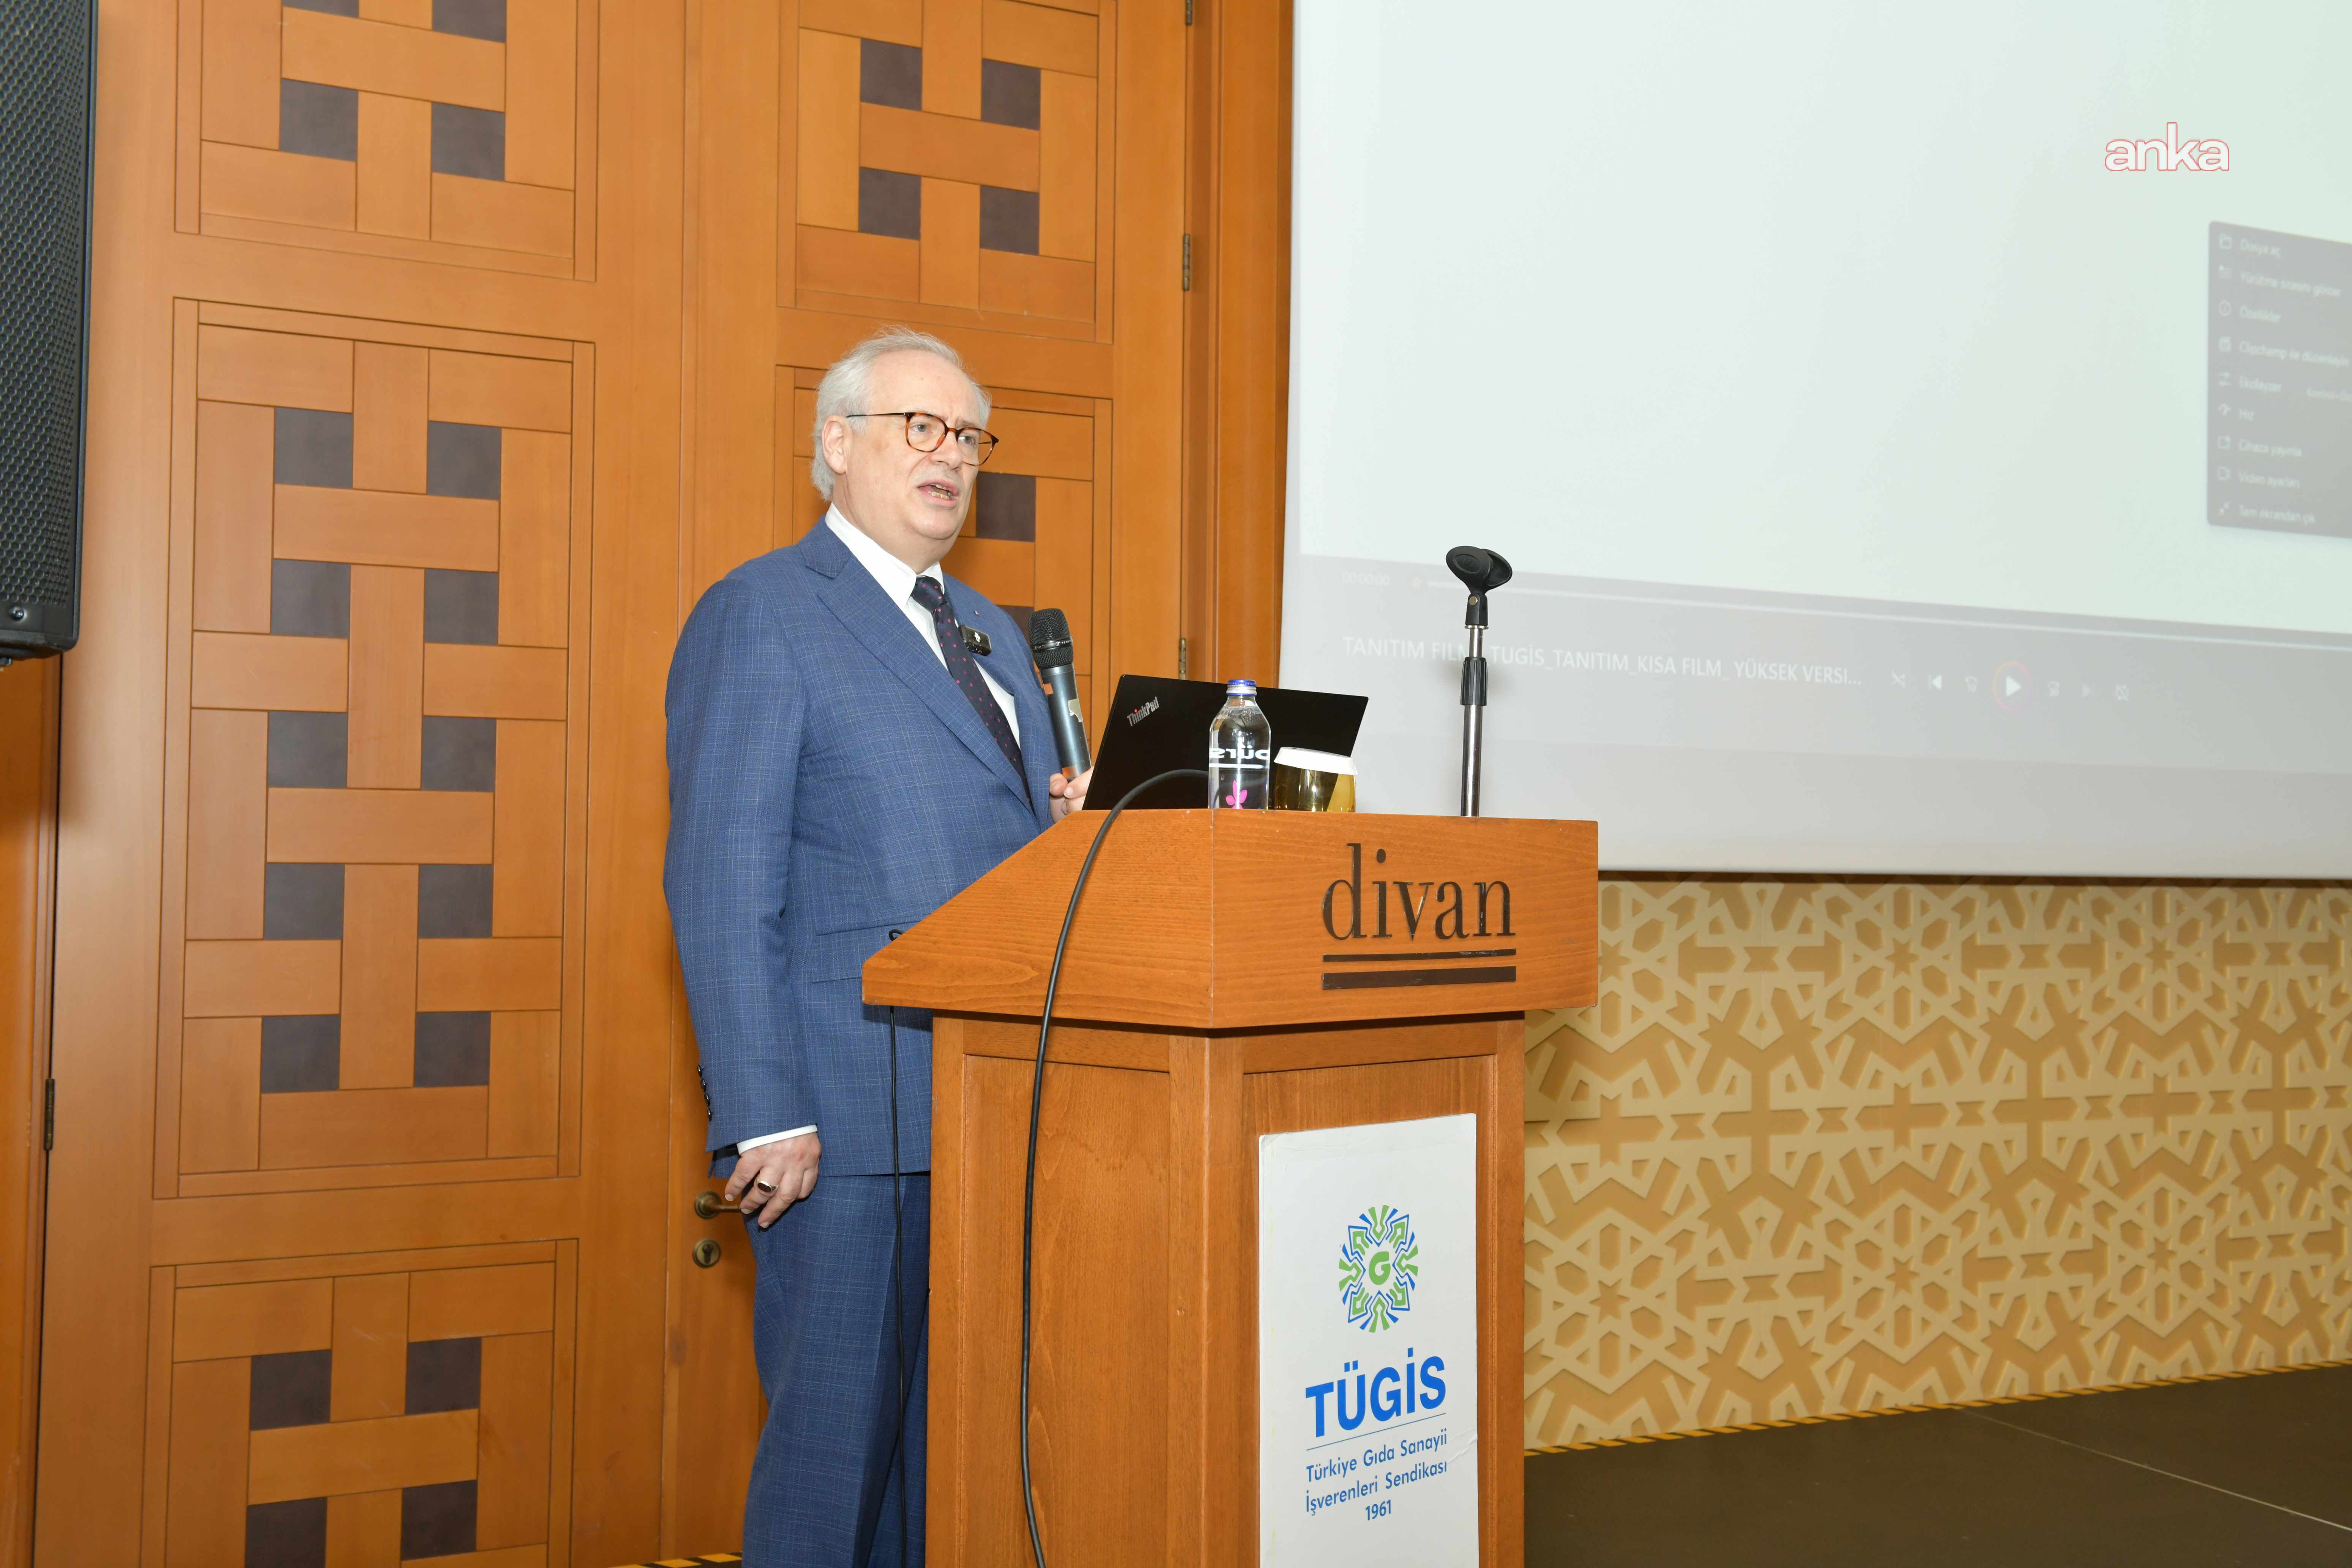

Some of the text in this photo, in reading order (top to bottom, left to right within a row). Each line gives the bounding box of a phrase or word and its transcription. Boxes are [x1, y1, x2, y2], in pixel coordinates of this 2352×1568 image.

[1342, 636, 1424, 659] TANITIM
[1734, 658, 1799, 681] YÜKSEK
[1127, 696, 1159, 727] ThinkPad
[1322, 843, 1516, 941] divan
[1368, 1251, 1391, 1285] G
[1306, 1347, 1446, 1438] TÜGİS
[1306, 1428, 1447, 1482] Türkiye Gıda Sanayii
[1306, 1461, 1447, 1516] İşverenleri Sendikası
[1365, 1499, 1392, 1521] 1961
